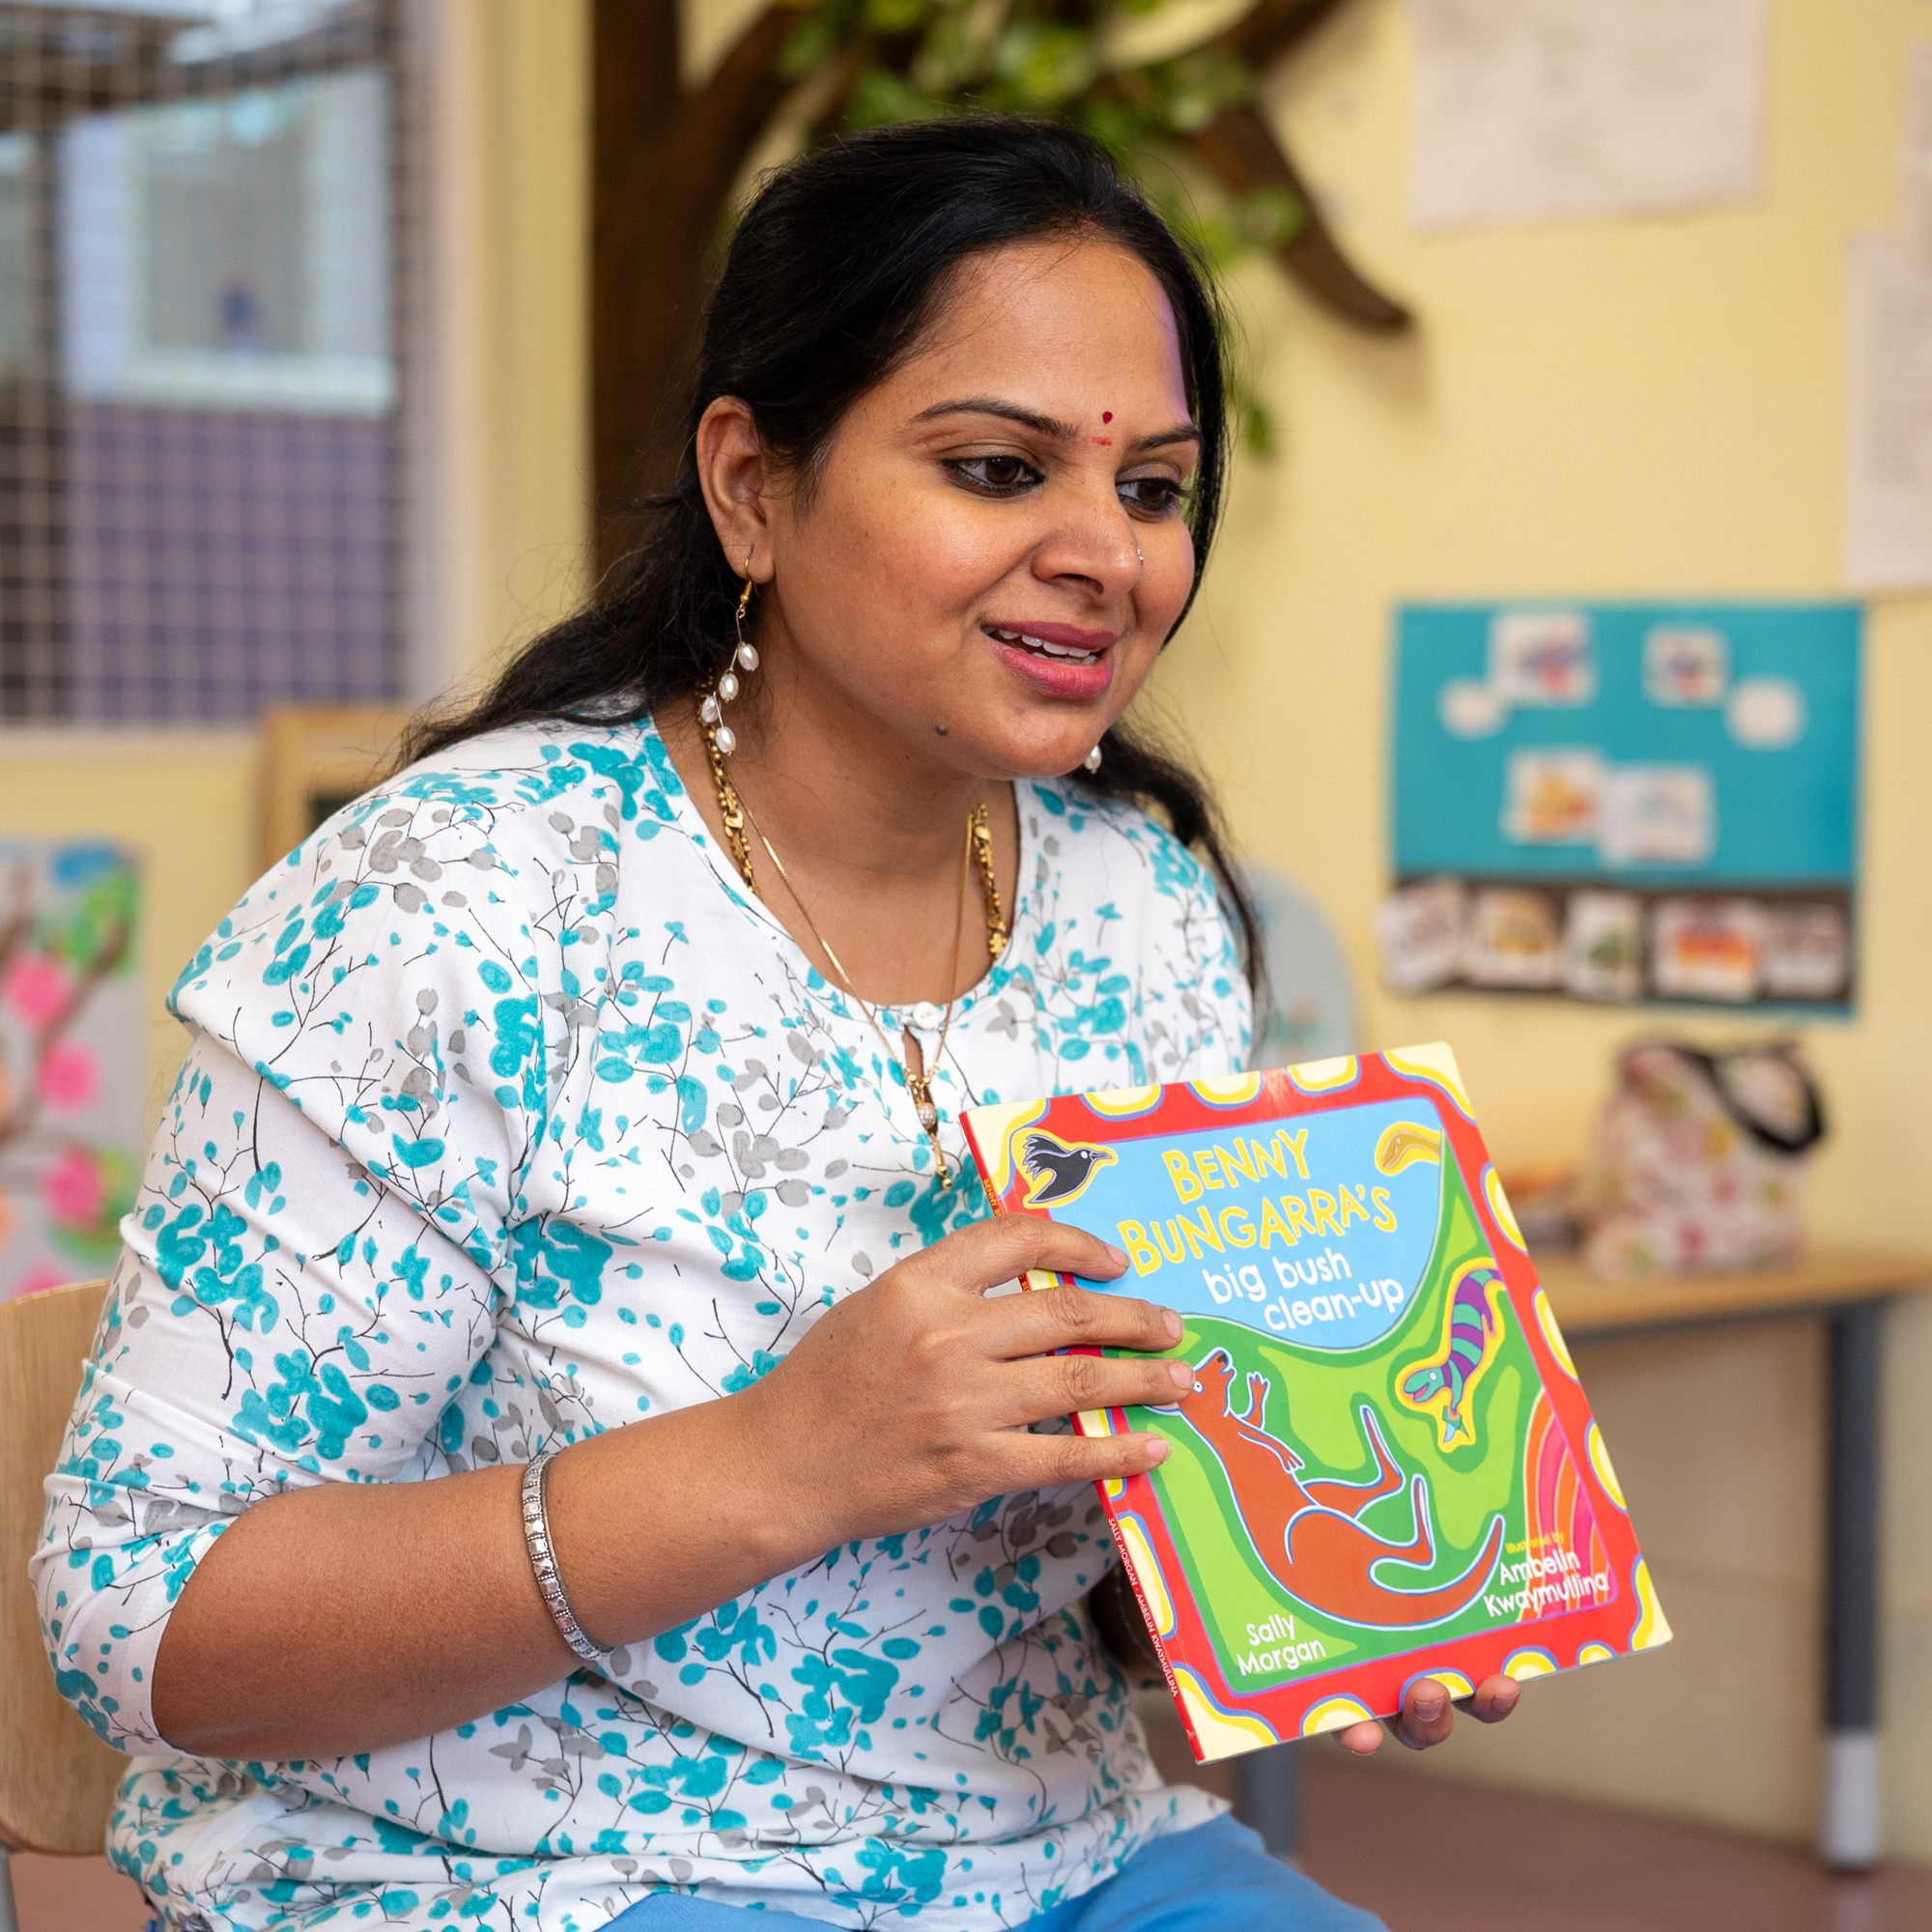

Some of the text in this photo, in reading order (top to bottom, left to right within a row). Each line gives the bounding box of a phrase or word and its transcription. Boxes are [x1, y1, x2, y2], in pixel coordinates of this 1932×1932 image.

[1161, 1129, 1310, 1204] BENNY
[982, 1179, 998, 1207] BENNY
[1117, 1183, 1397, 1277] BUNGARRA'S
[1202, 1247, 1352, 1304] big bush
[1264, 1277, 1404, 1331] clean-up
[1551, 1532, 1564, 1544] by
[1500, 1548, 1580, 1585] Ambelin
[1108, 1518, 1179, 1697] SALLY MORGAN AMBELIN KWAYMULLINA
[1484, 1573, 1609, 1617] Kwaymullina
[1246, 1613, 1295, 1646] Sally
[1236, 1640, 1327, 1676] Morgan
